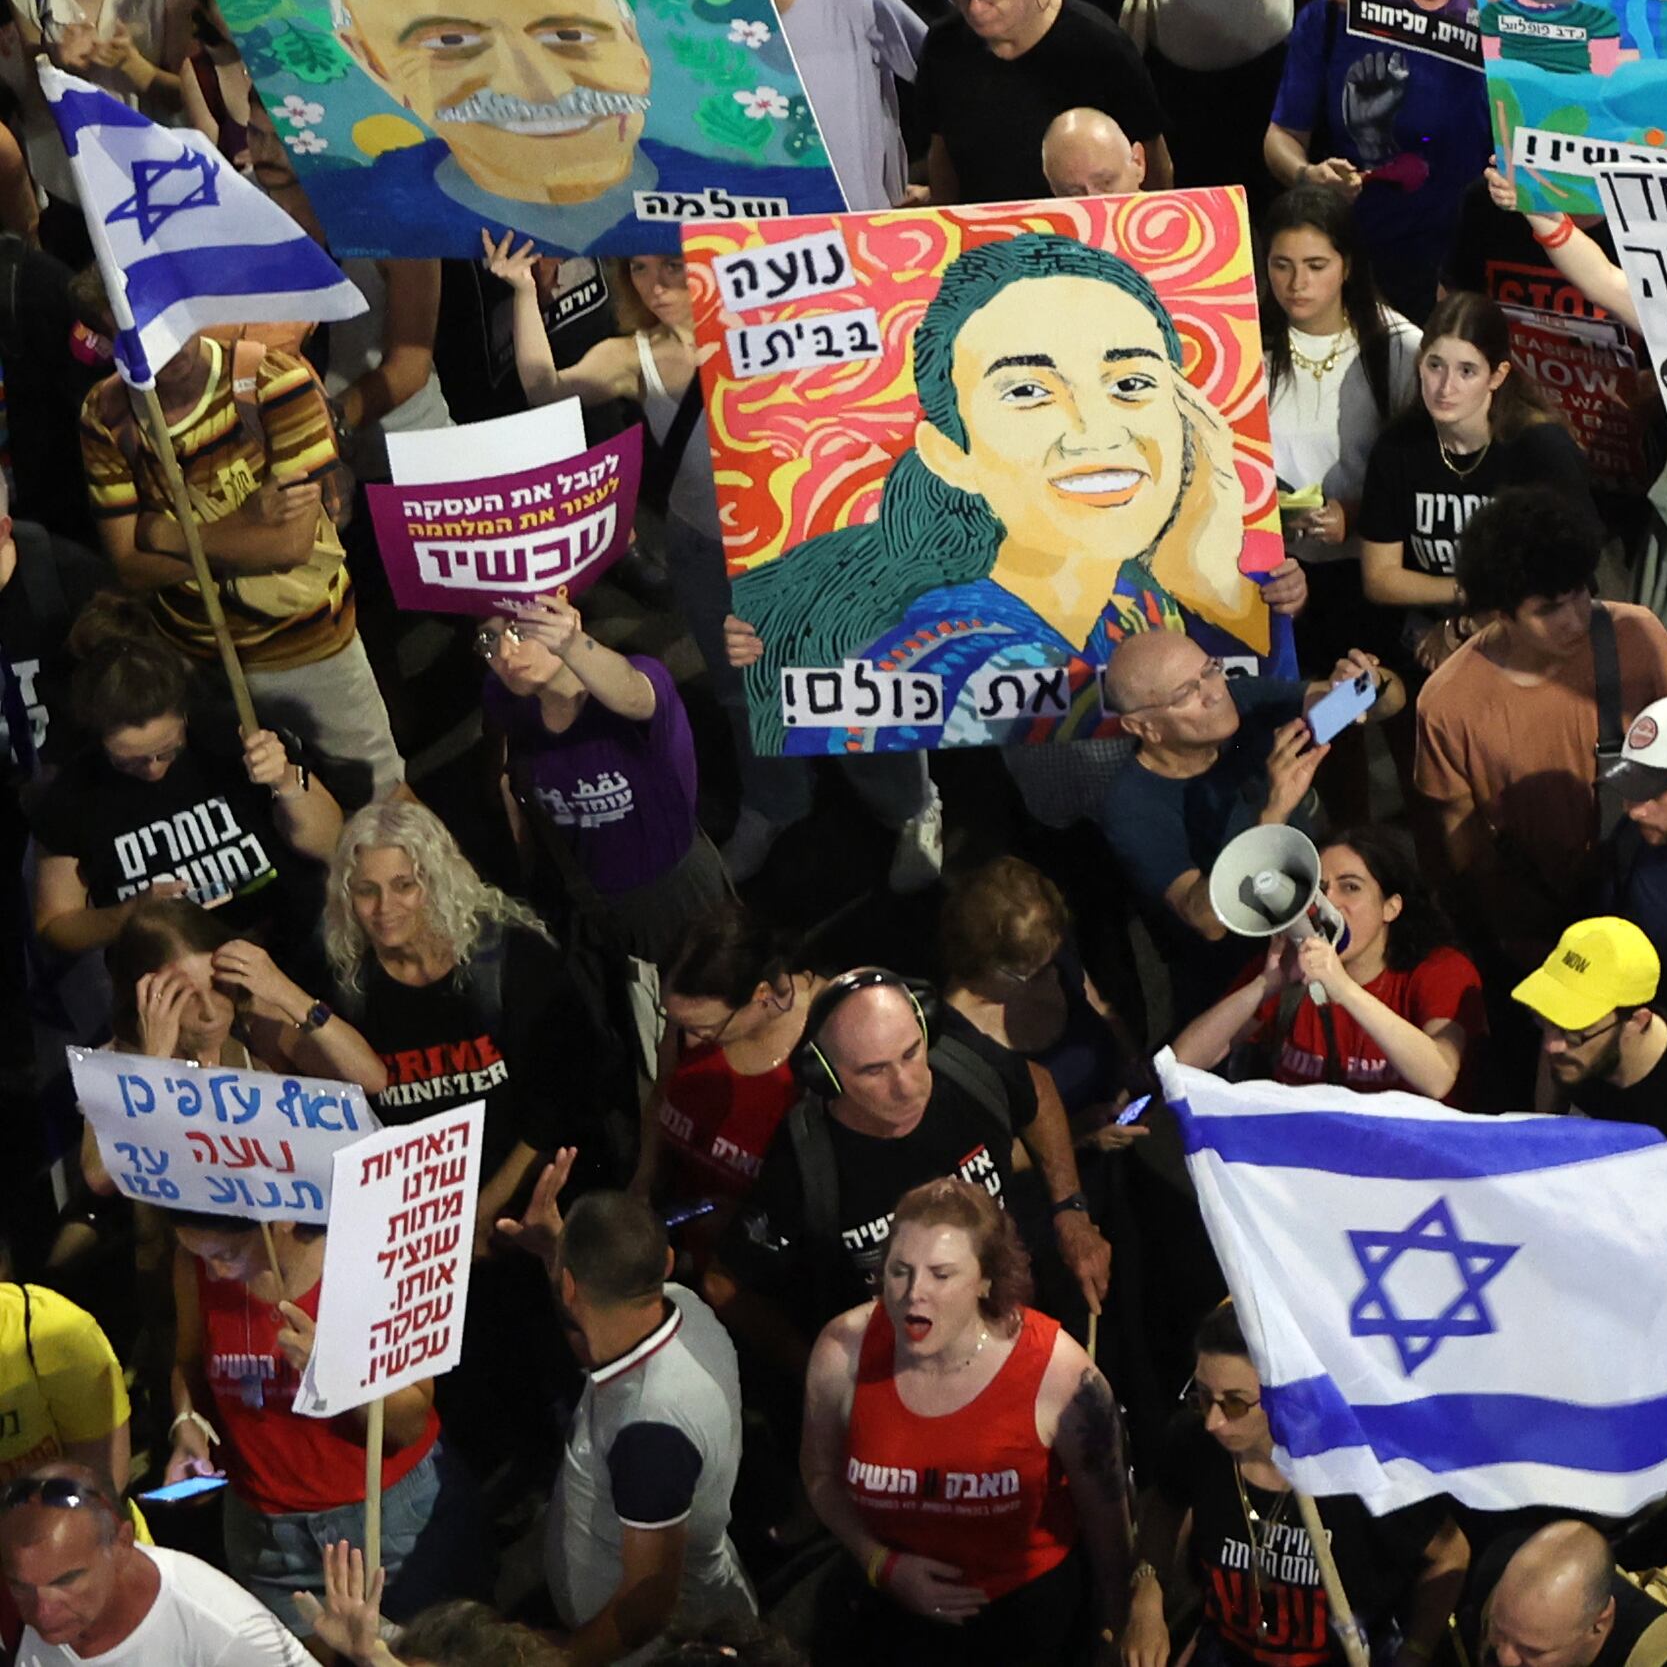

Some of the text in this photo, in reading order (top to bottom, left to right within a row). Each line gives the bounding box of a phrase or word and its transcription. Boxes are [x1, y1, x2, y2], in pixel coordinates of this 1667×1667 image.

[1359, 1, 1479, 54] חיים, סליחה!
[641, 189, 782, 219] שלמה
[725, 242, 848, 300] נועה
[736, 319, 879, 371] בבית!
[403, 453, 620, 518] לקבל את העסקה
[408, 476, 621, 538] לעצור את המלחמה
[428, 508, 607, 588] עכשיו
[784, 661, 1066, 726] את כולם!
[114, 795, 243, 881] בוחרים
[116, 1072, 156, 1118] כן
[166, 1076, 204, 1110] פי
[276, 1079, 359, 1132] ואף
[379, 1058, 509, 1108] MINISTER
[114, 1129, 296, 1177] נועה עד
[359, 1120, 470, 1187] האחיות
[120, 1172, 324, 1212] תנוע 120
[400, 1155, 467, 1205] שלנו
[386, 1188, 463, 1246] מתות
[376, 1222, 460, 1278] שנציל
[389, 1259, 457, 1309] אותן.
[368, 1293, 453, 1351] עסקה
[358, 1326, 451, 1387] עכשיו.
[848, 1456, 1021, 1501] מאבק הנשים
